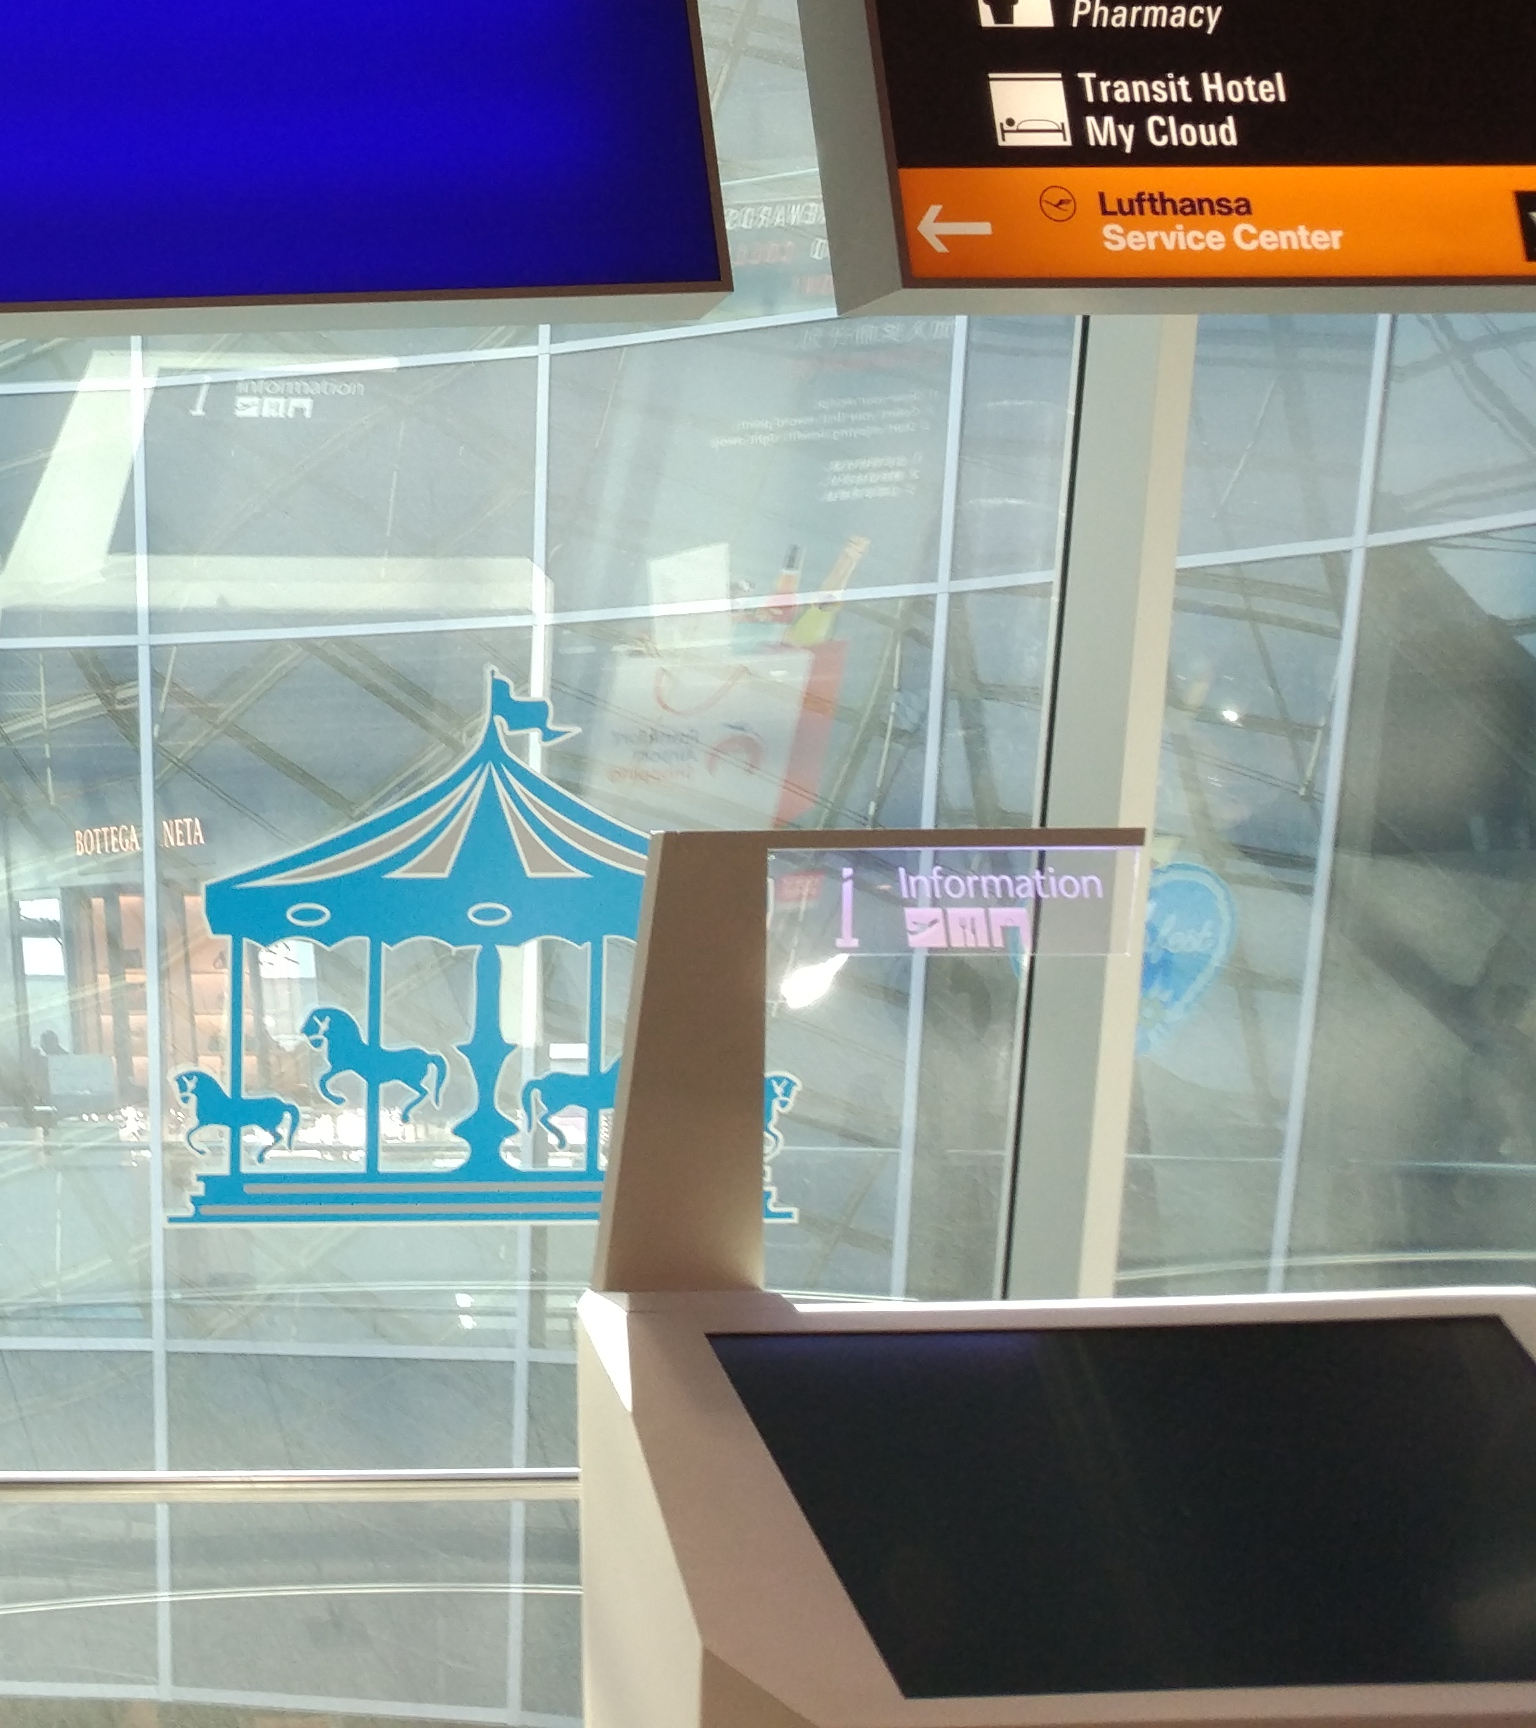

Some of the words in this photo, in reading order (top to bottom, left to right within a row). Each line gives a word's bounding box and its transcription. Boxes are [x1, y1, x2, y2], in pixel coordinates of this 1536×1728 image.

[1077, 72, 1193, 103] Transit
[1201, 72, 1286, 103] Hotel
[1085, 115, 1135, 154] My
[1147, 114, 1238, 147] Cloud
[1098, 190, 1253, 218] Lufthansa
[1102, 224, 1226, 253] Service
[1233, 224, 1344, 252] Center
[74, 824, 141, 857] BOTTEGA
[160, 817, 206, 849] NETA
[897, 865, 1104, 901] Information
